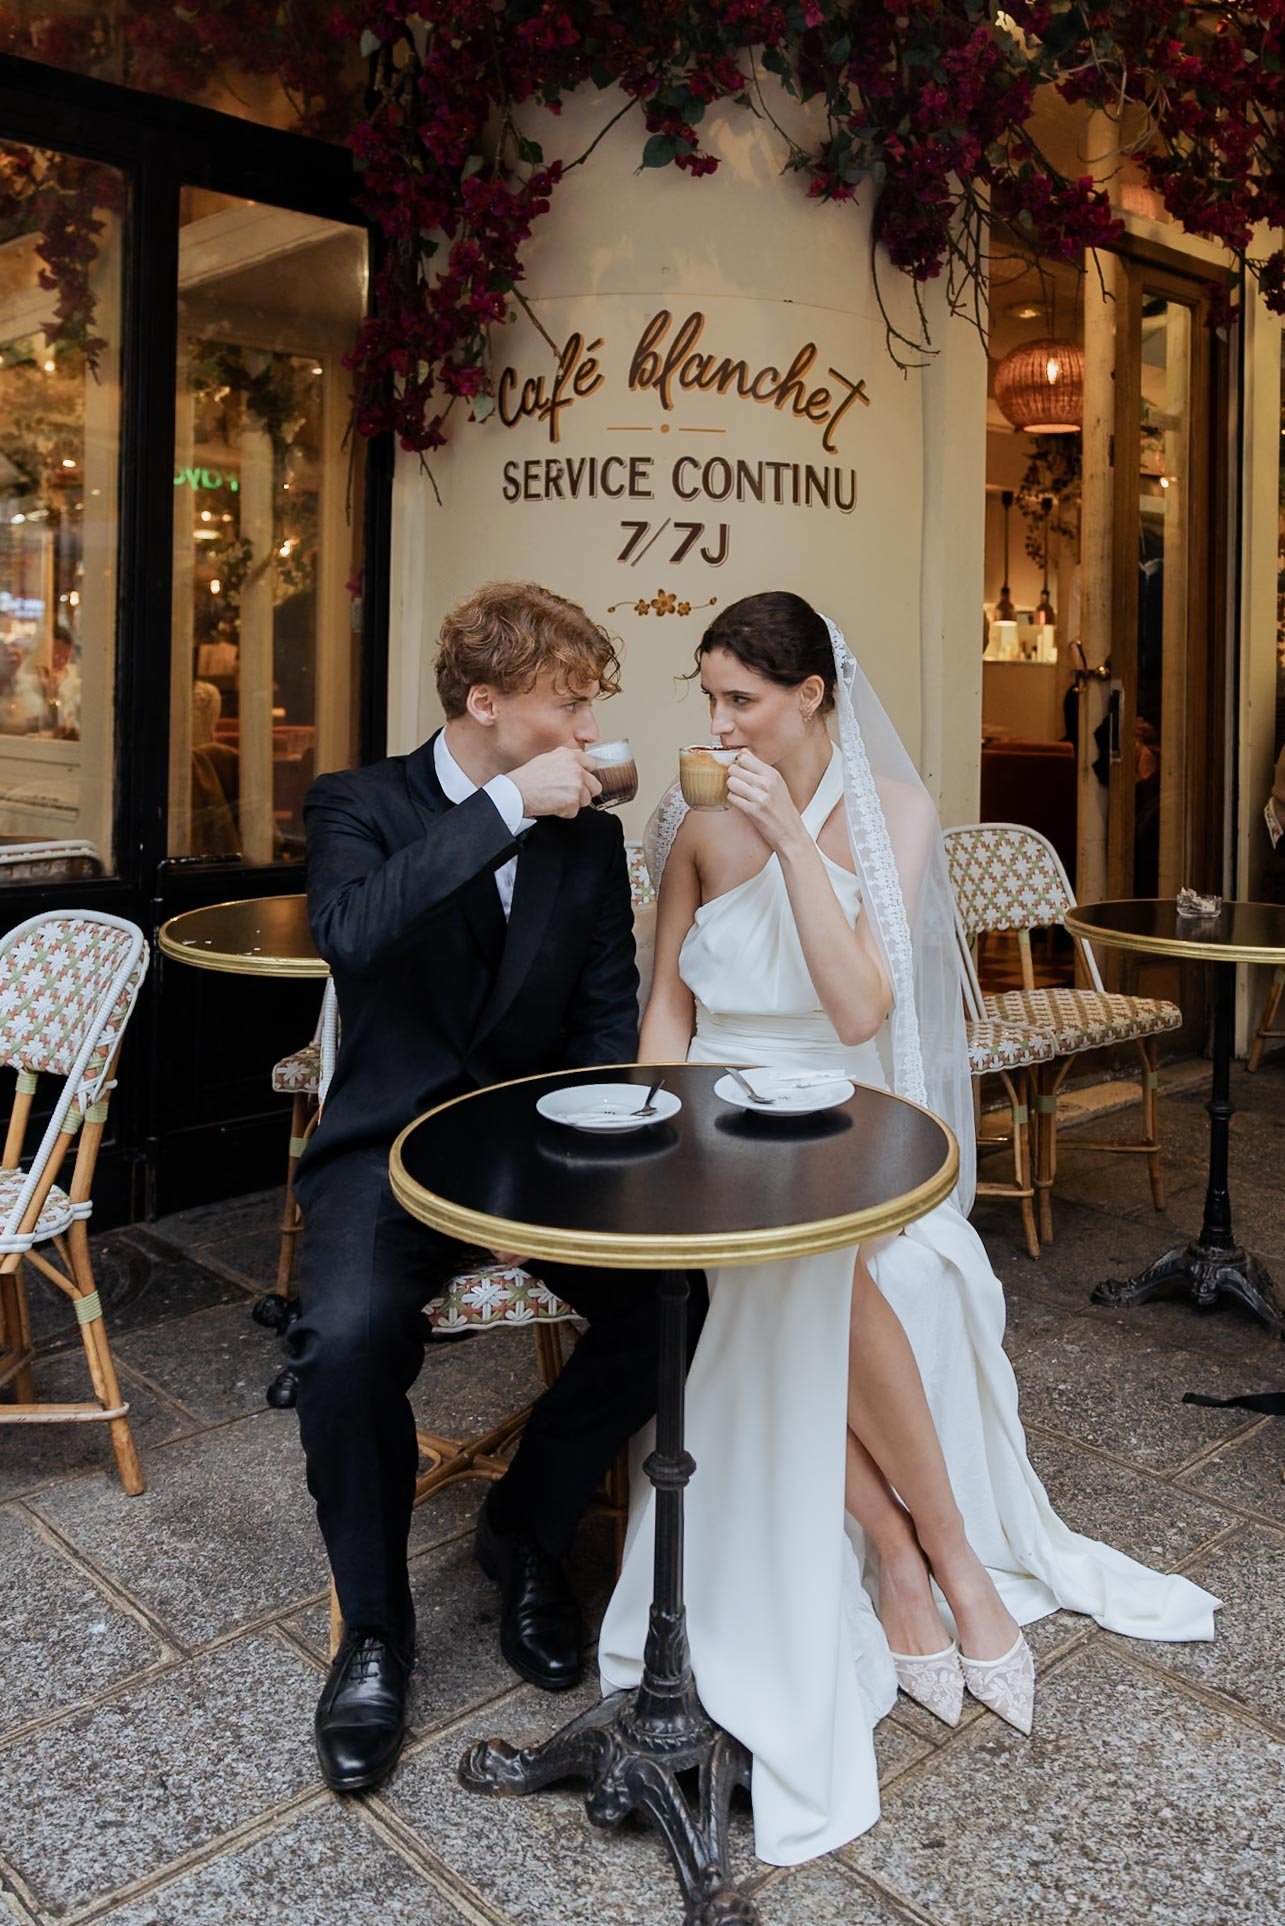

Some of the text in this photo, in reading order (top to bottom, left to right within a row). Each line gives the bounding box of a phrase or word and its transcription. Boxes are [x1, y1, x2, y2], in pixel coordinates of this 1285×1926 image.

[499, 309, 871, 455] Café blanchet
[502, 456, 857, 514] SERVICE CONTINU
[616, 517, 730, 567] 7/7J
